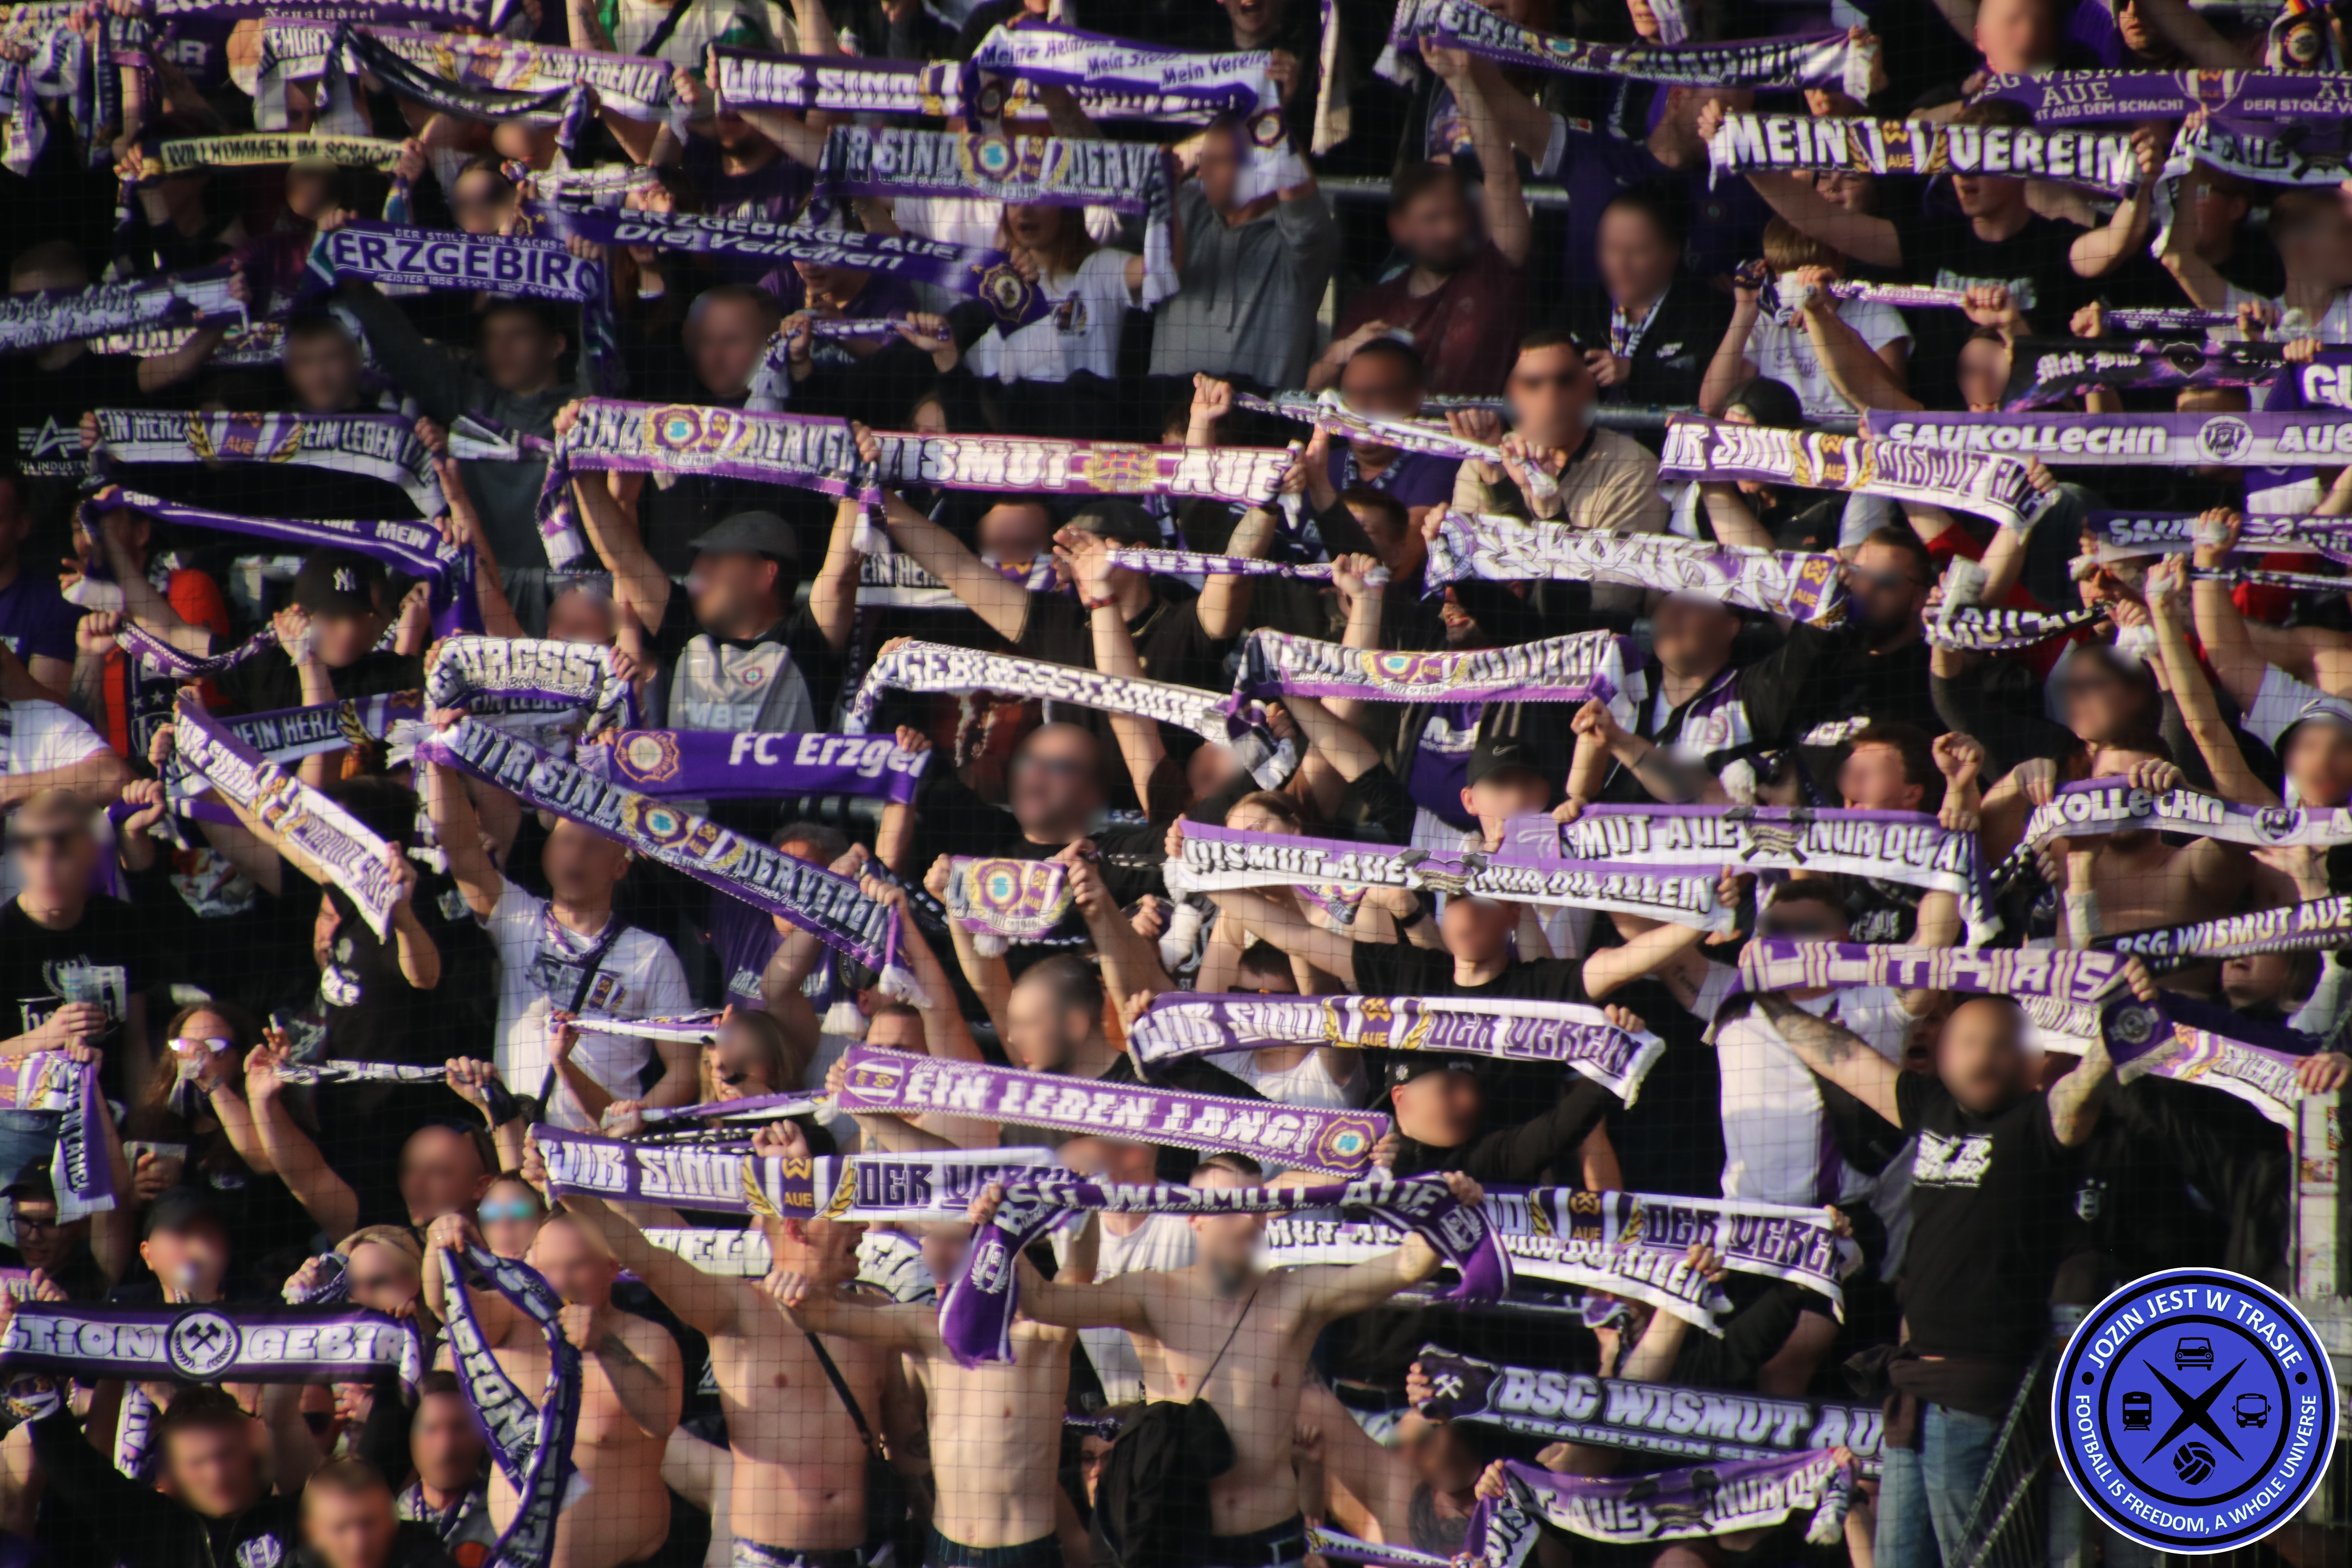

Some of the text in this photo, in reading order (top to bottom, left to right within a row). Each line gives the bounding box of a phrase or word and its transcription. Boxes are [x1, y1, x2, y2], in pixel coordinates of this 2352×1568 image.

[815, 67, 920, 111] SIND
[1161, 67, 1205, 85] Mein
[2042, 82, 2113, 107] AUE
[2052, 99, 2184, 118] AUS DEM SCHACHT
[2243, 100, 2276, 112] DER
[2279, 100, 2332, 113] STOLZ
[167, 138, 290, 168] WILLKOMMEN
[297, 140, 318, 157] IM
[879, 127, 961, 179] SIND
[1726, 114, 2132, 187] MEIN VEREIN
[1888, 154, 1913, 168] AUE
[395, 228, 420, 240] DER
[427, 231, 469, 242] STOLZ
[476, 235, 507, 246] VON
[615, 223, 904, 270] Die Veilchen
[619, 208, 867, 246] ERZGEBIRGE
[877, 238, 962, 260] AUE
[377, 272, 523, 292] MEISTER 1956 1957
[97, 411, 132, 441] EIN
[304, 421, 338, 450] EIN
[342, 421, 399, 463] LEBEN
[225, 435, 256, 455] AUE
[1169, 446, 1293, 503] AUE
[1712, 425, 1791, 477] SIND
[1876, 442, 1991, 495] WISMUT
[1824, 464, 1846, 481] AUE
[375, 520, 432, 550] MEIN
[1422, 667, 1443, 676] AUE
[283, 708, 338, 746] HERZ
[728, 732, 784, 766] FC
[459, 716, 536, 793] WIR
[535, 762, 630, 825] SIND
[736, 840, 796, 894] DER
[689, 838, 707, 857] AUE
[1668, 814, 1739, 849] AUE
[1806, 821, 1878, 857] NUR
[1879, 824, 1933, 866] DU
[1181, 838, 1329, 878] WISMUT
[1334, 850, 1406, 883] AUE
[1480, 864, 1543, 895] NUR
[1603, 874, 1714, 913] ALLEIN
[1023, 898, 1042, 908] AUE
[2176, 906, 2292, 955] WISMUT
[2297, 896, 2352, 932] AUE
[1133, 1002, 1226, 1063] WIR
[1223, 1001, 1323, 1044] SIND
[1426, 1009, 1500, 1054] DER
[1360, 1031, 1388, 1046] AUE
[904, 1071, 993, 1110] EIN
[999, 1080, 1158, 1131] LEBEN
[538, 1139, 934, 1207] WIR SIND DER
[784, 1192, 813, 1209] AUE
[1571, 1227, 1602, 1240] AUE
[1645, 1203, 1722, 1247] DER
[1497, 1366, 1601, 1420] BSG
[1604, 1379, 1812, 1447] WISMUT
[1506, 1416, 1713, 1457] TRADITION
[1569, 1493, 1643, 1533] AUE
